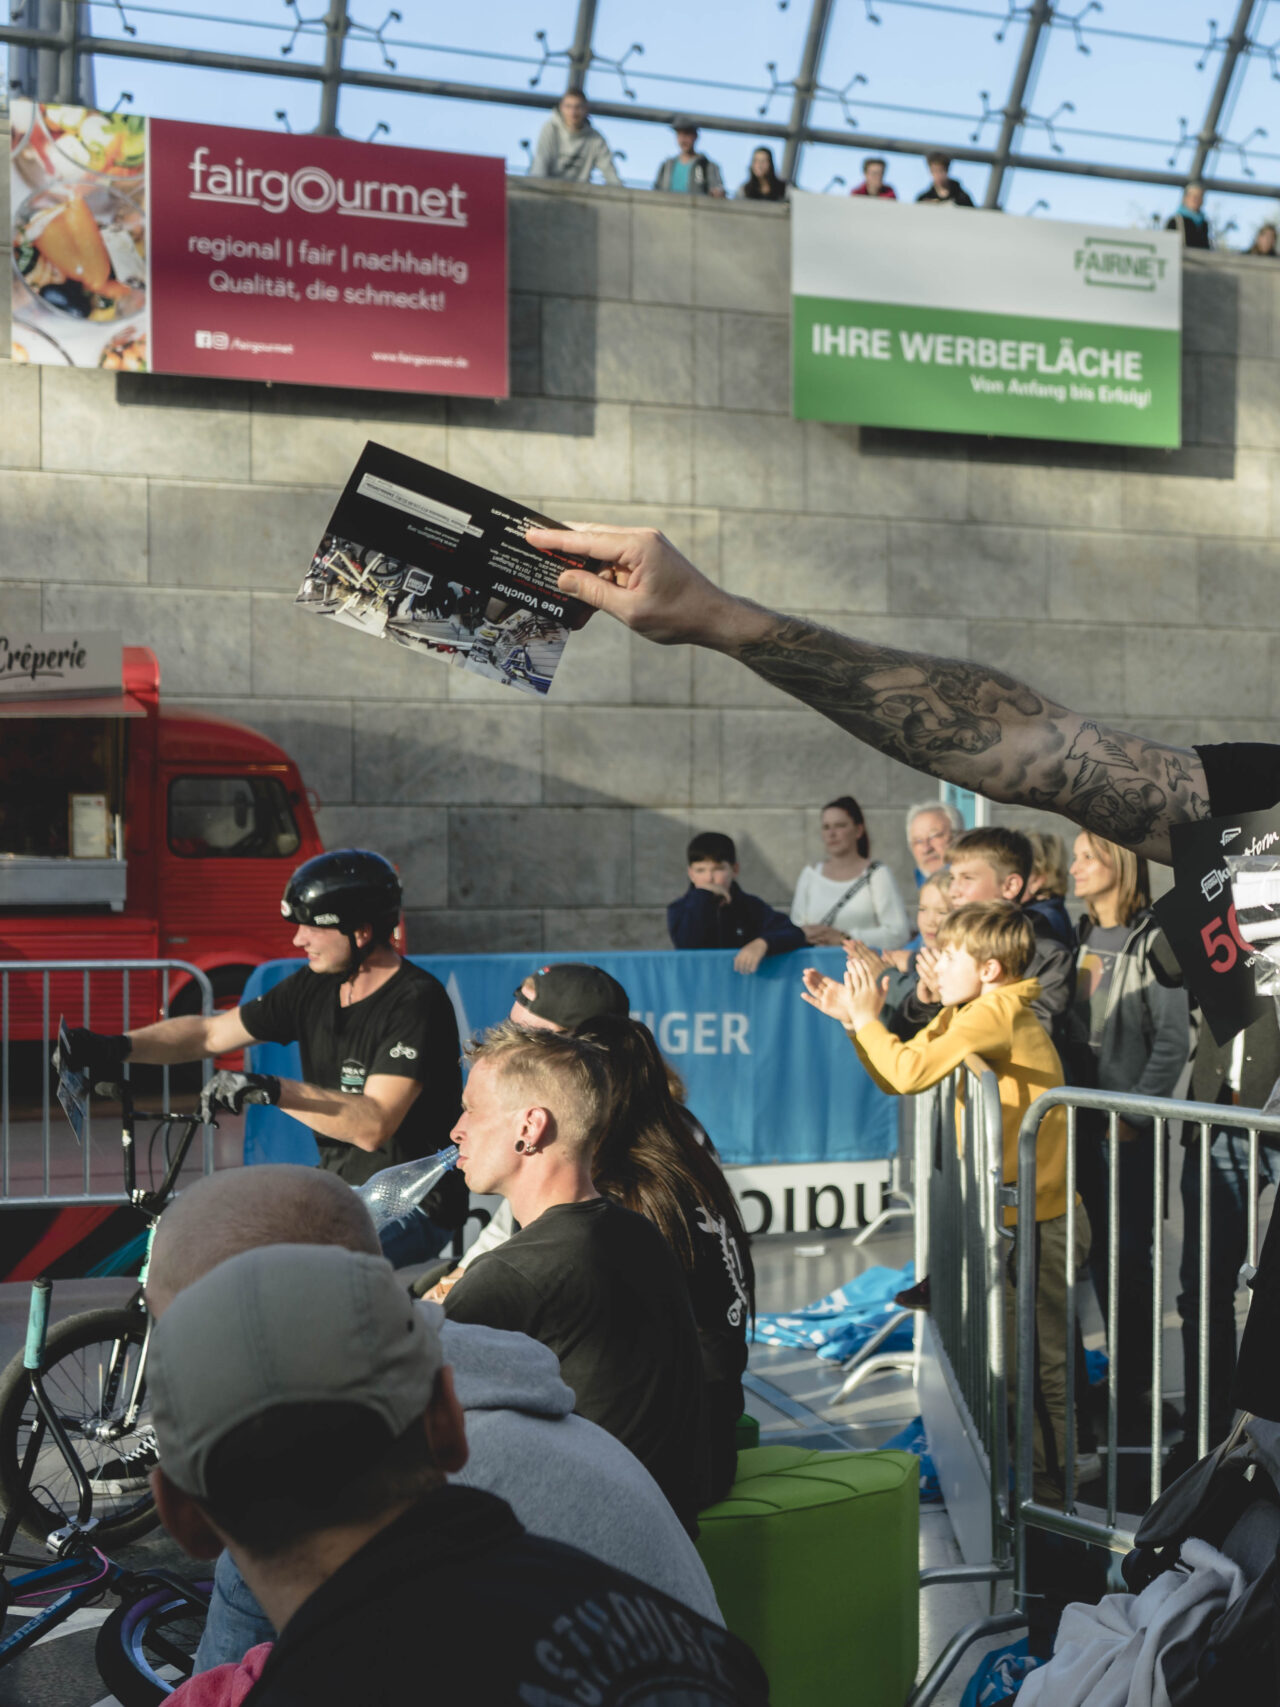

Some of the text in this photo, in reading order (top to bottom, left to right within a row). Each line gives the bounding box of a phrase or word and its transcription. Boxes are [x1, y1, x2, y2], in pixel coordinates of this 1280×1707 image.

[188, 235, 282, 261] regional
[298, 240, 336, 265] fair
[352, 249, 469, 284] nachhaltig
[1073, 249, 1168, 281] FAIRNET
[208, 270, 446, 311] Qualität, die schmeckt!
[811, 323, 1143, 382] IHRE WERBEFLÄCHE
[970, 373, 1152, 410] Von Anfang bis Erfolg!
[490, 580, 564, 617] Use Voucher
